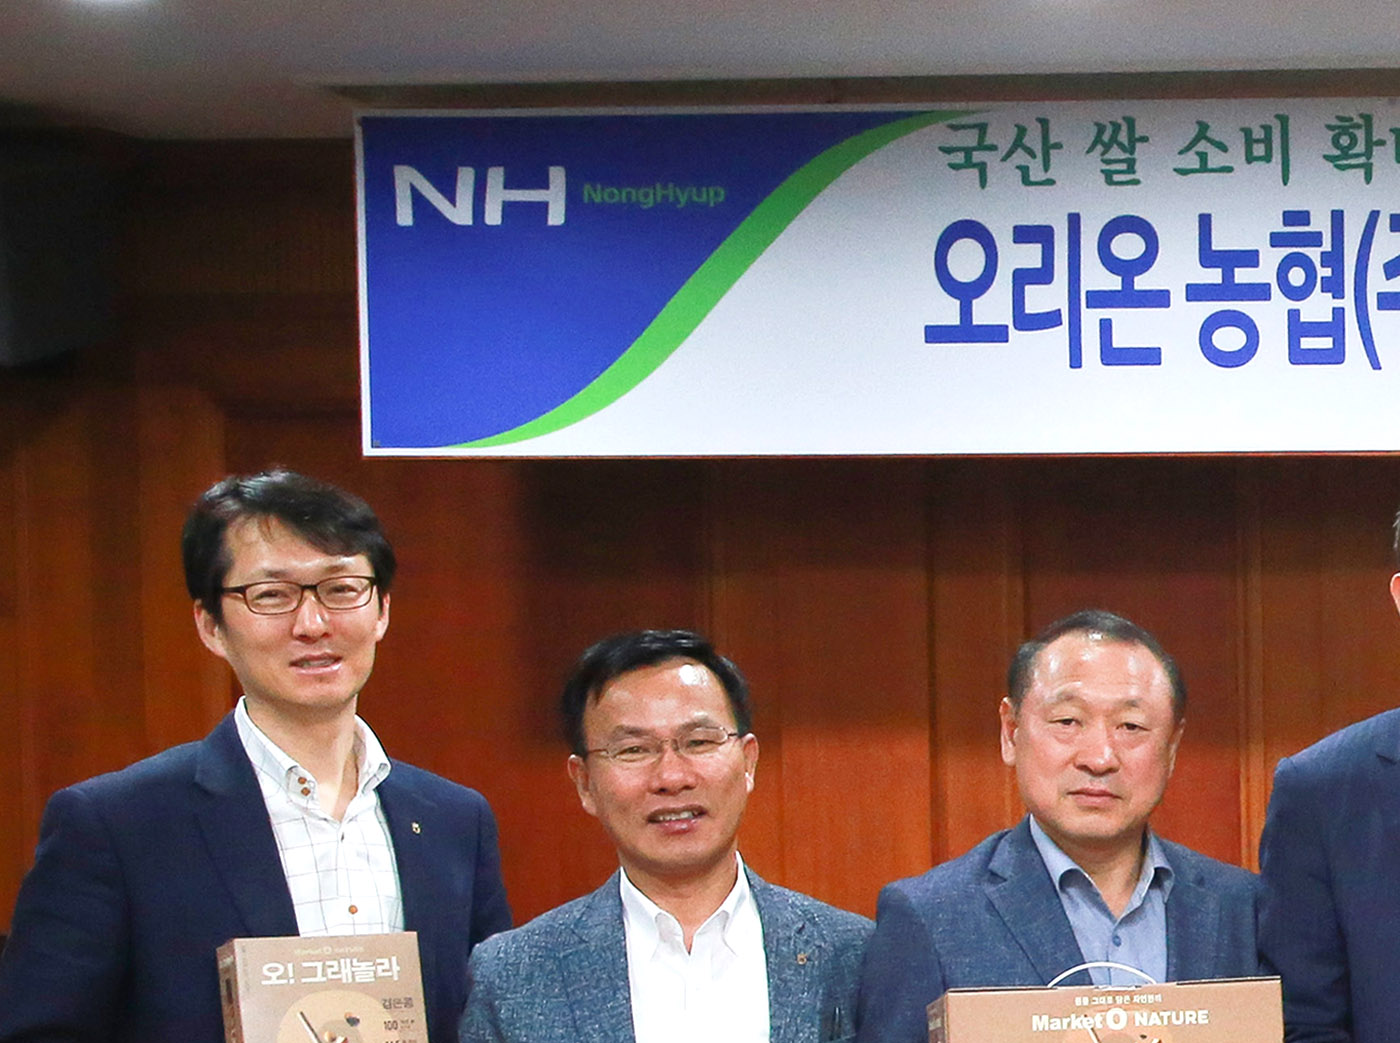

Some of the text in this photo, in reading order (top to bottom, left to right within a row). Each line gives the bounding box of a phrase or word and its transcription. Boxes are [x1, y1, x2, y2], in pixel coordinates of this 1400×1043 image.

[939, 120, 1062, 187] 국산
[1086, 119, 1150, 187] 쌀
[1174, 117, 1290, 187] 소비
[394, 165, 565, 226] NH
[583, 181, 726, 208] NongHyup
[924, 213, 1170, 369] 오리온
[261, 956, 400, 985] 오! 그래놀라
[1031, 1007, 1209, 1031] Market O NATURE
